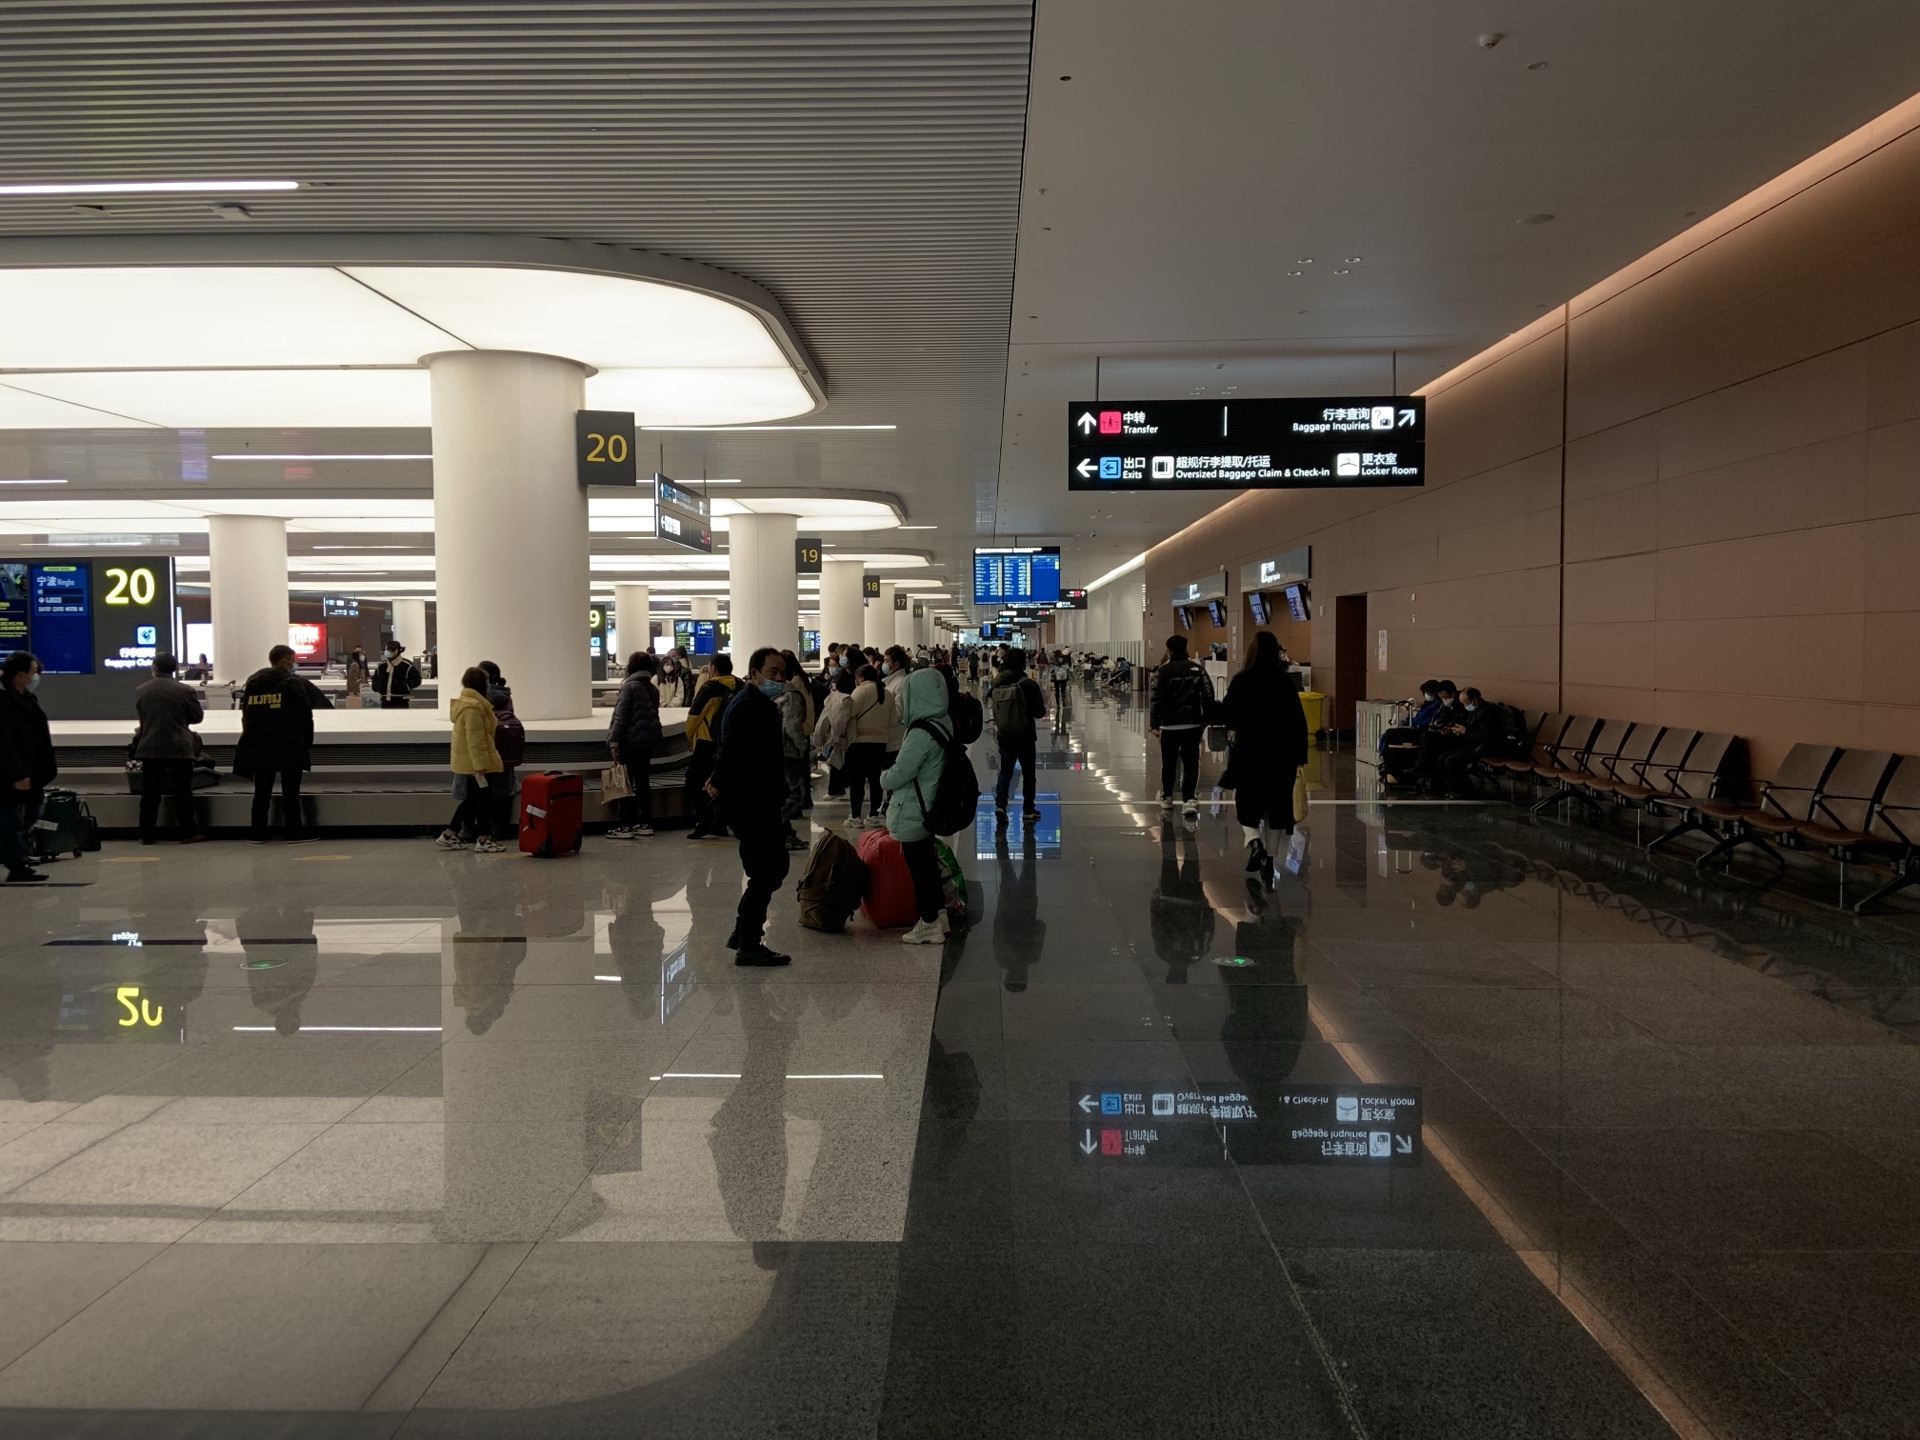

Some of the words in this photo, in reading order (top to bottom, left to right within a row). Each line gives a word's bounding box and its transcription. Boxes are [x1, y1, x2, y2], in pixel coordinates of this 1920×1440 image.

[1123, 411, 1146, 424] 中转
[1323, 408, 1370, 420] 行李查询
[1124, 426, 1158, 434] Transfer
[1292, 423, 1330, 433] Baggage
[1333, 422, 1370, 432] Inquiries
[586, 433, 628, 463] 20
[1124, 457, 1146, 468] 出口
[1176, 455, 1271, 469] 超规行李提取/托运
[1362, 453, 1398, 465] 更衣室
[1123, 471, 1142, 479] Exits
[1176, 470, 1217, 478] Oversized
[1218, 470, 1256, 480] Baggage
[1258, 469, 1282, 478] Claim
[1284, 469, 1291, 477] &
[1293, 468, 1330, 477] Check-in
[1362, 467, 1389, 476] Locker
[1392, 466, 1418, 475] Room
[801, 548, 818, 562] 19
[105, 568, 155, 604] 20
[867, 582, 878, 591] 18
